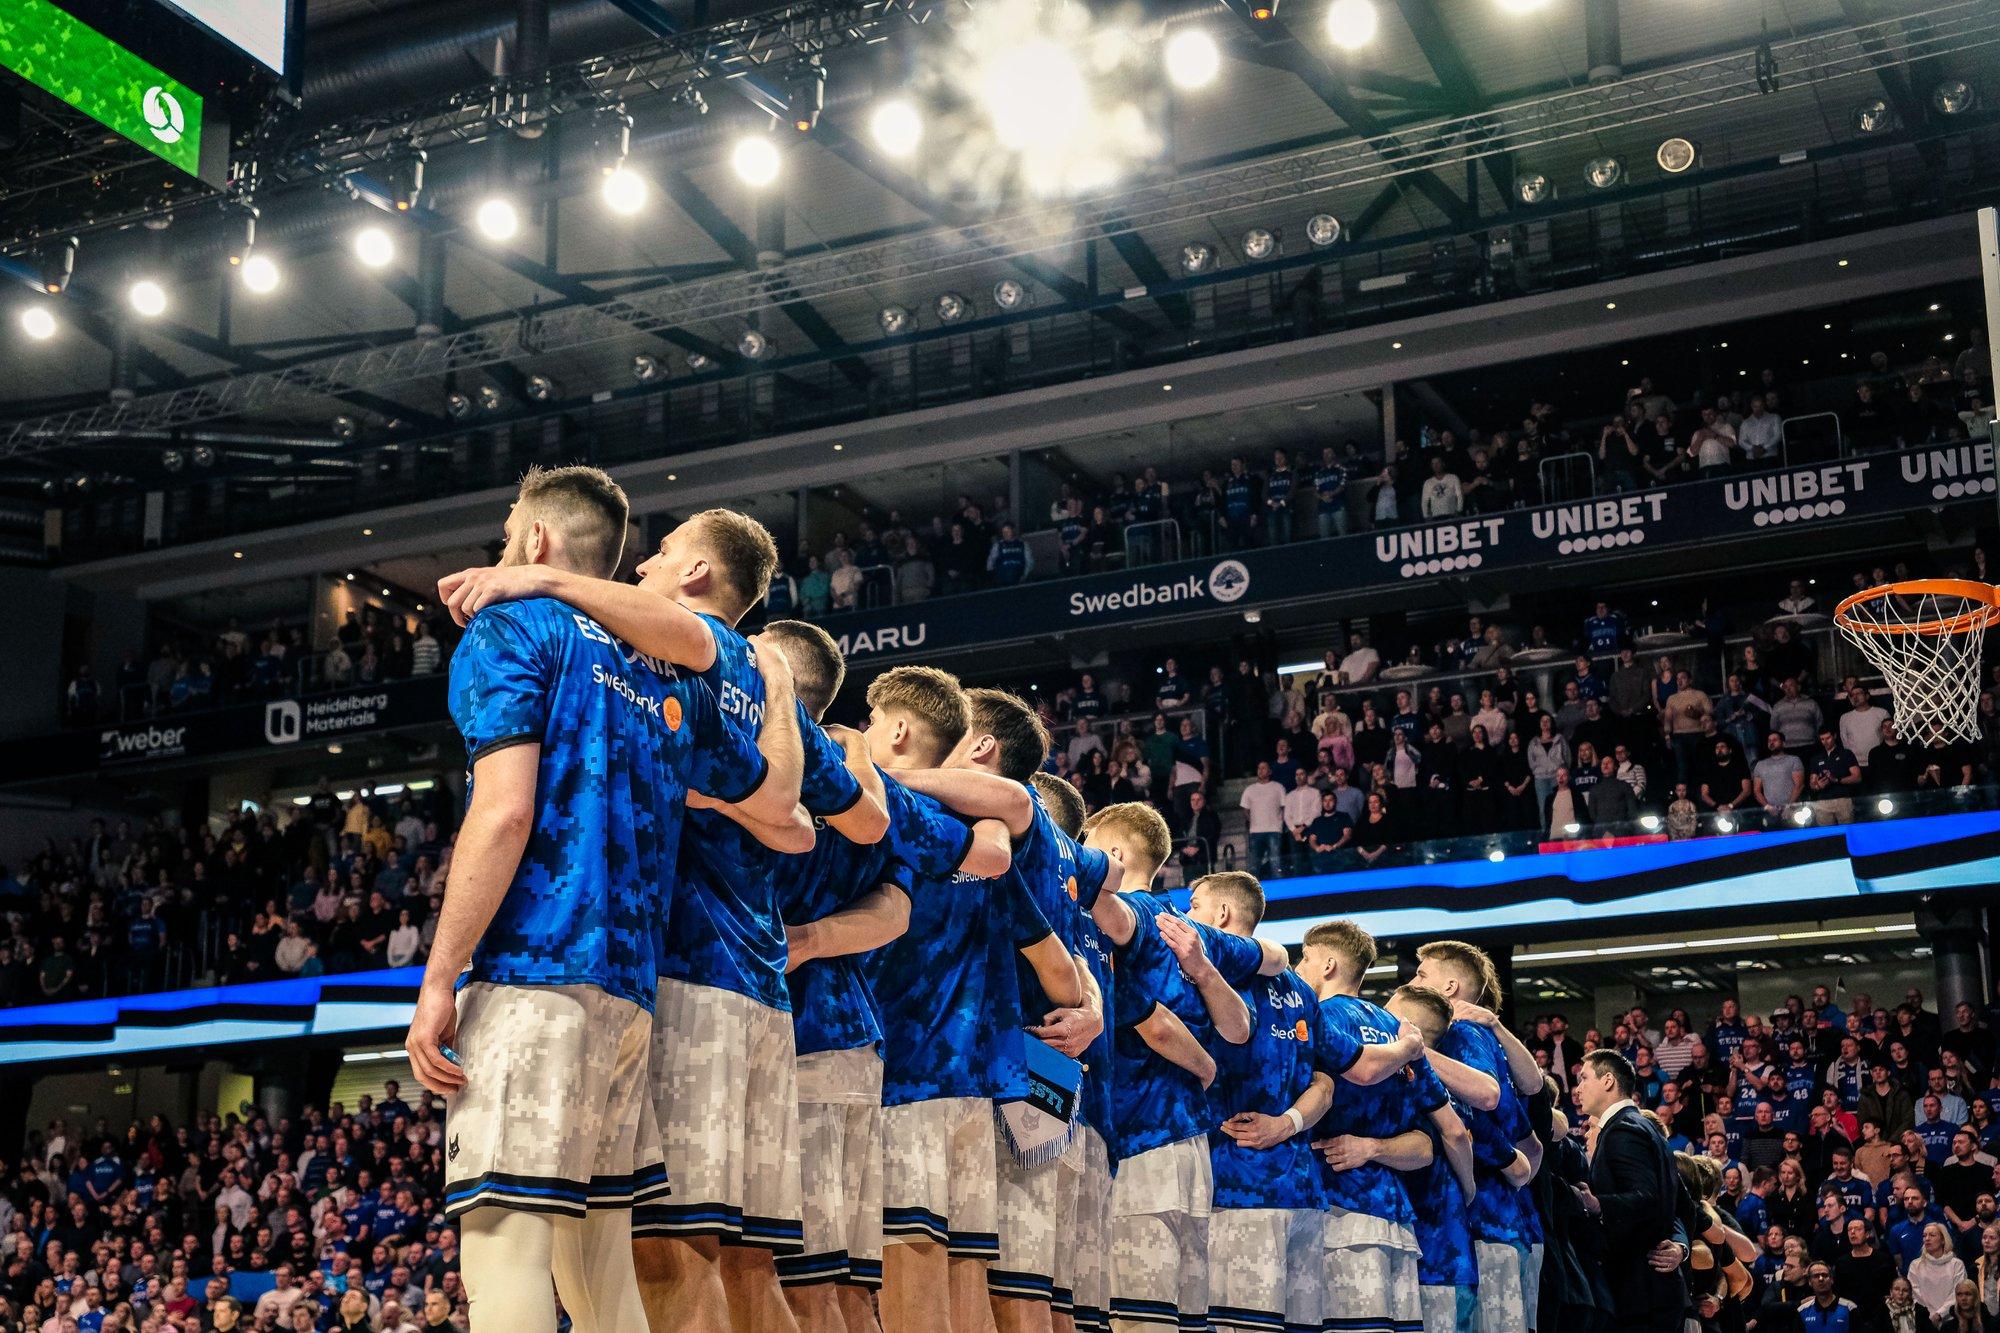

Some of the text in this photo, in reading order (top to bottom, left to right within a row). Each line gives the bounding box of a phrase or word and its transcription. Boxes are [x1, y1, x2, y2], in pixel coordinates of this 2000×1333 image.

[1724, 461, 1870, 511] UNIBET
[1532, 492, 1668, 539] UNIBET
[1376, 518, 1505, 562] UNIBET
[1070, 574, 1203, 616] Swedbank
[306, 709, 376, 734] Materials
[307, 694, 387, 716] Heidelberg
[117, 726, 186, 752] weber
[1741, 1087, 1757, 1099] 24
